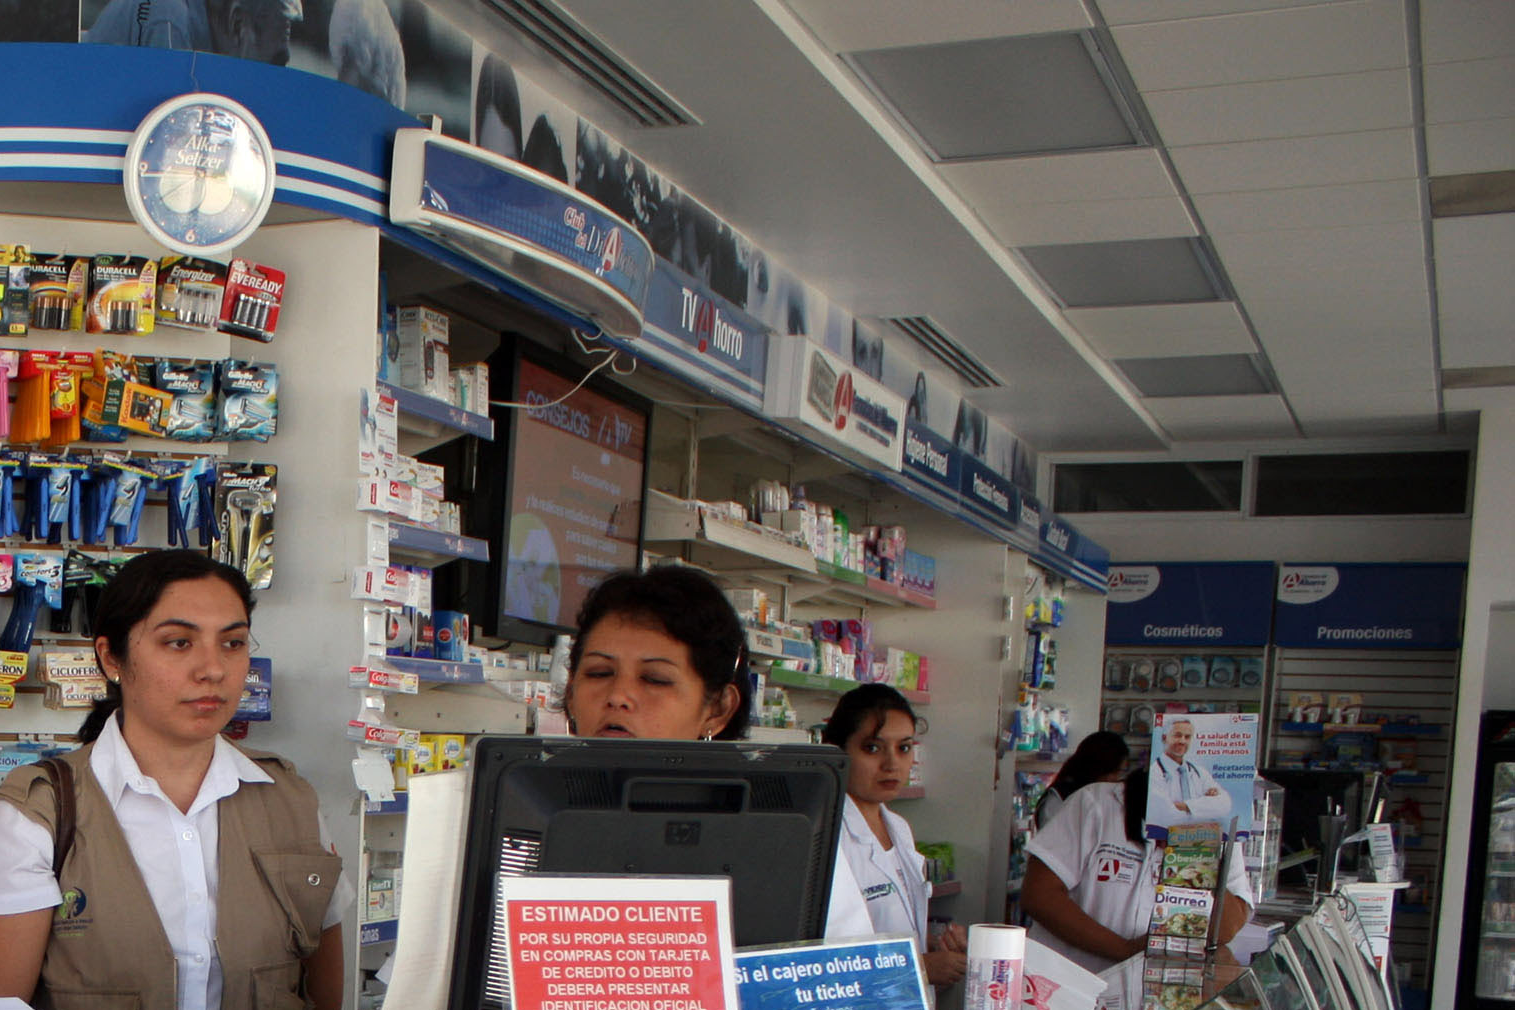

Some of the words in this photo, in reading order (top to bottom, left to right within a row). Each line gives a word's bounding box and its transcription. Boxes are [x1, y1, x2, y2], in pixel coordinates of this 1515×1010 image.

[175, 150, 225, 169] Seltzer
[185, 229, 196, 242] 6
[96, 266, 138, 275] DURACELL
[171, 265, 215, 283] Energizer
[231, 272, 283, 294] EVEREADY
[121, 387, 133, 423] Kodak
[526, 390, 590, 438] CONSEJOS
[1144, 624, 1223, 638] Cosméticos
[1317, 625, 1413, 641] Promociones
[1165, 853, 1216, 864] Obesidad
[1155, 892, 1207, 908] Diarrea
[522, 906, 619, 922] ESTIMADO
[625, 906, 703, 923] CLIENTE
[519, 933, 547, 945] POR
[552, 933, 571, 945] SU
[575, 933, 624, 945] PROPIA
[628, 933, 707, 945] SEGURIDAD
[521, 950, 538, 962] EN
[543, 950, 612, 962] COMPRAS
[616, 950, 645, 962] CON
[648, 950, 711, 961] TARJETA
[542, 967, 560, 979] DE
[565, 967, 625, 979] CREDITO
[630, 967, 640, 979] O
[643, 967, 693, 979] DEBITO
[734, 967, 748, 984] Si
[753, 965, 768, 981] el
[772, 959, 822, 984] cajero
[826, 955, 871, 975] olvida
[874, 953, 907, 969] darte
[548, 984, 605, 996] DEBERA
[608, 983, 690, 995] PRESENTAR
[795, 988, 813, 1003] tu
[817, 981, 861, 1001] ticket
